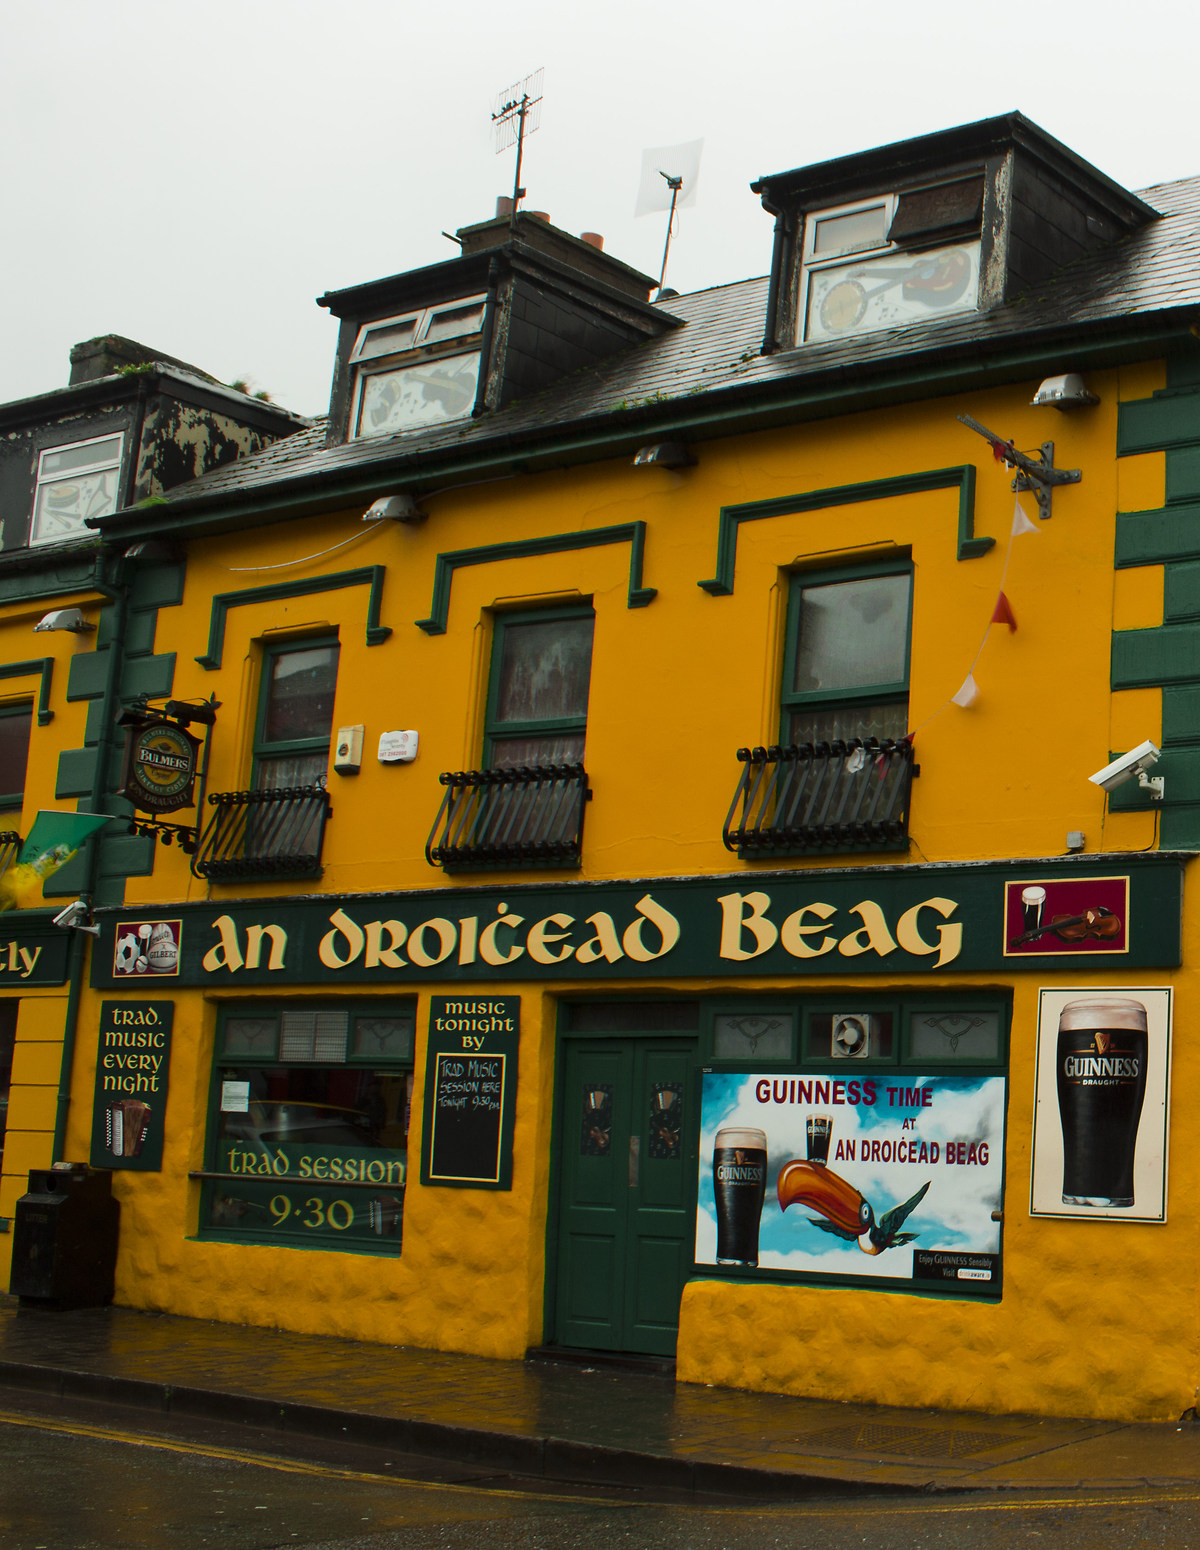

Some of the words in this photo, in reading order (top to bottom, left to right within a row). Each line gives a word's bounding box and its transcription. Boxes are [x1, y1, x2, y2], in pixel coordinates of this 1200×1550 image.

[140, 748, 188, 770] BULMERS
[150, 950, 177, 959] GILBERT
[440, 1059, 465, 1078] TRAD
[468, 1060, 498, 1078] MUSIC
[1064, 1055, 1139, 1078] GUINNESS
[440, 1081, 479, 1094] SESSION
[755, 1079, 877, 1106] GUINNESS
[886, 1087, 933, 1107] TIME
[902, 1118, 916, 1131] AT
[835, 1138, 856, 1162] AN
[945, 1142, 990, 1165] BEAG
[717, 1165, 762, 1181] GUINNESS
[919, 1254, 934, 1266] Enjoy
[934, 1253, 968, 1266] GUINNESS
[968, 1257, 993, 1269] Sensibly
[942, 1267, 956, 1277] Visit
